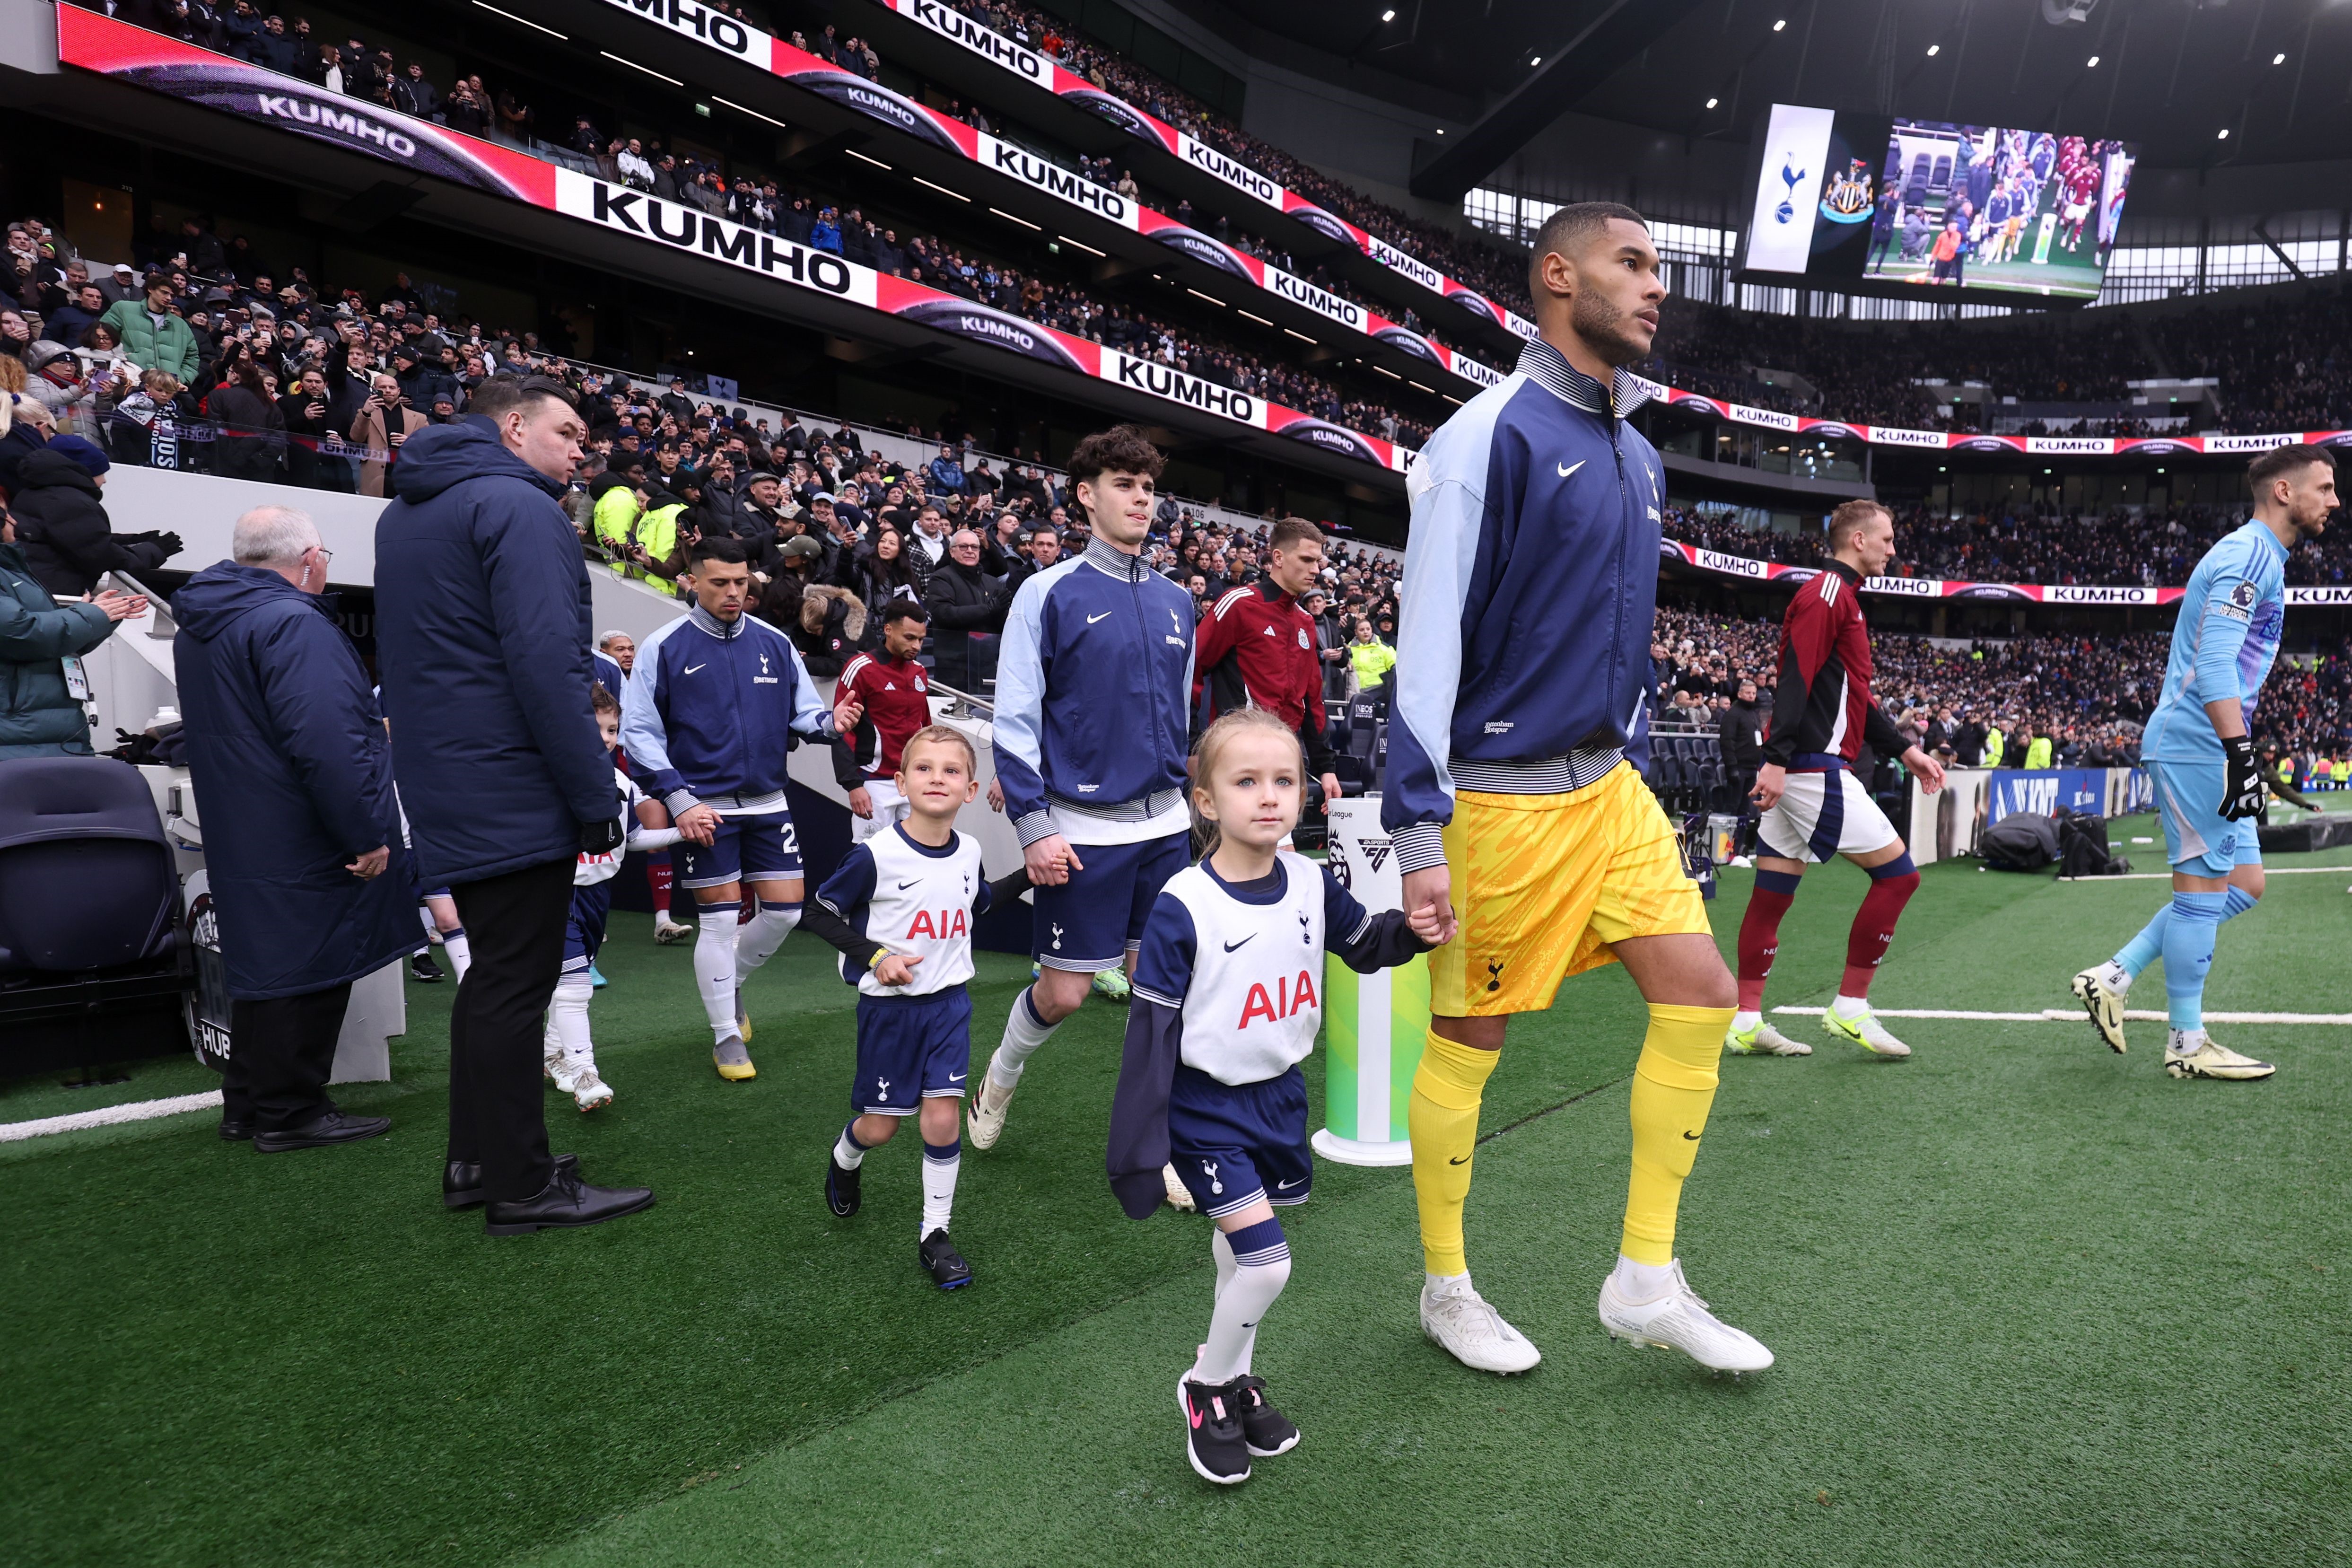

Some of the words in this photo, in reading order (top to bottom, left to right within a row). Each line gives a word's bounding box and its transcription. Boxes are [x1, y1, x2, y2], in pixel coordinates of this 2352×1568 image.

[914, 0, 1040, 78] KUMHO
[848, 87, 915, 126] KUMHO
[258, 94, 416, 158] KUMHO
[996, 143, 1124, 219] KUMHO
[1189, 142, 1272, 200] KUMHO
[593, 181, 850, 294] KUMHO
[1312, 215, 1342, 237] KUMHO
[1183, 238, 1225, 264] KUMHO
[1275, 272, 1357, 325] KUMHO
[961, 316, 1033, 350] KUMHO
[1119, 356, 1252, 421] KUMHO
[1736, 408, 1790, 427] KUMHO
[1312, 430, 1355, 452] KUMHO
[1876, 429, 1939, 444] KUMHO
[2035, 441, 2105, 451] KUMHO
[2213, 437, 2292, 449] KUMHO
[1703, 552, 1759, 575] KUMHO
[2054, 588, 2144, 601] KUMHO
[1355, 704, 1373, 713] INEOS
[1331, 809, 1353, 819] League
[906, 909, 966, 940] AIA
[1237, 970, 1318, 1030] AIA
